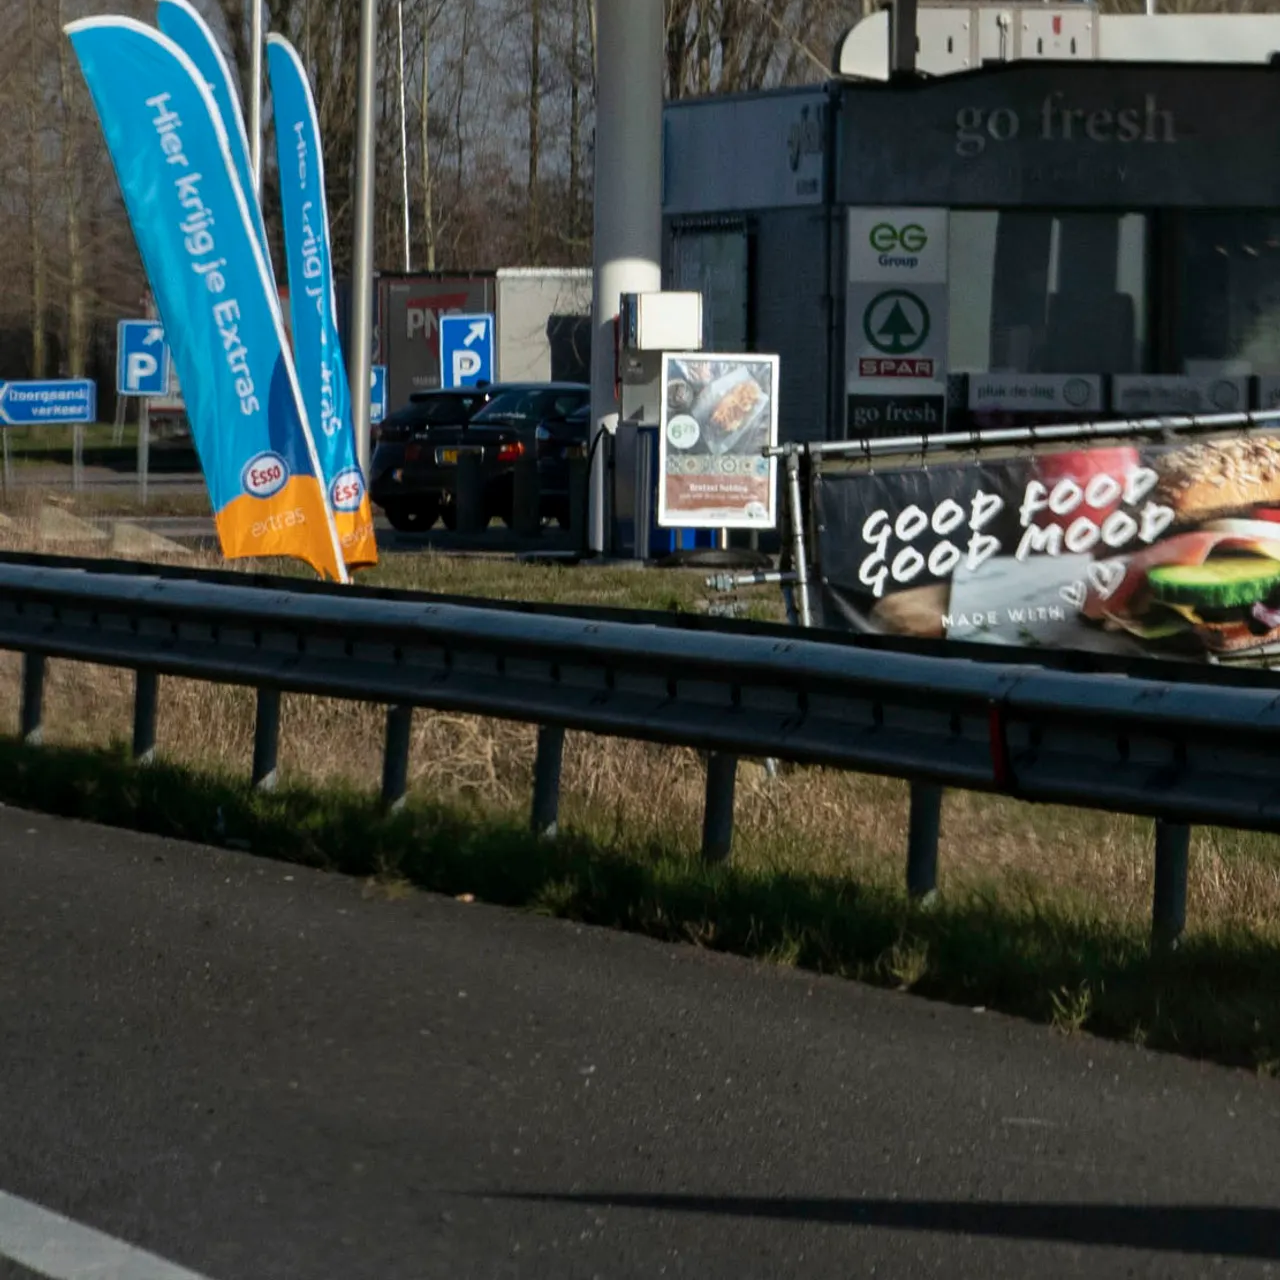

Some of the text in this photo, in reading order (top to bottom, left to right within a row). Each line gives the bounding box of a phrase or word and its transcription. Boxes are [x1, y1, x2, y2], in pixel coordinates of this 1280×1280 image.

[955, 90, 1178, 157] go fresh
[145, 92, 261, 417] Hier krijg je Extras
[878, 254, 919, 269] Group
[127, 351, 158, 389] P
[452, 349, 482, 387] P
[861, 359, 933, 376] SPAR
[853, 399, 937, 428] go fresh
[251, 466, 281, 488] Esso
[335, 483, 360, 503] Ess
[252, 506, 306, 538] extras
[861, 466, 1160, 556] GOOD FOOD
[858, 500, 1176, 598] GOOD MOOD
[940, 604, 1066, 629] MADE WITH
